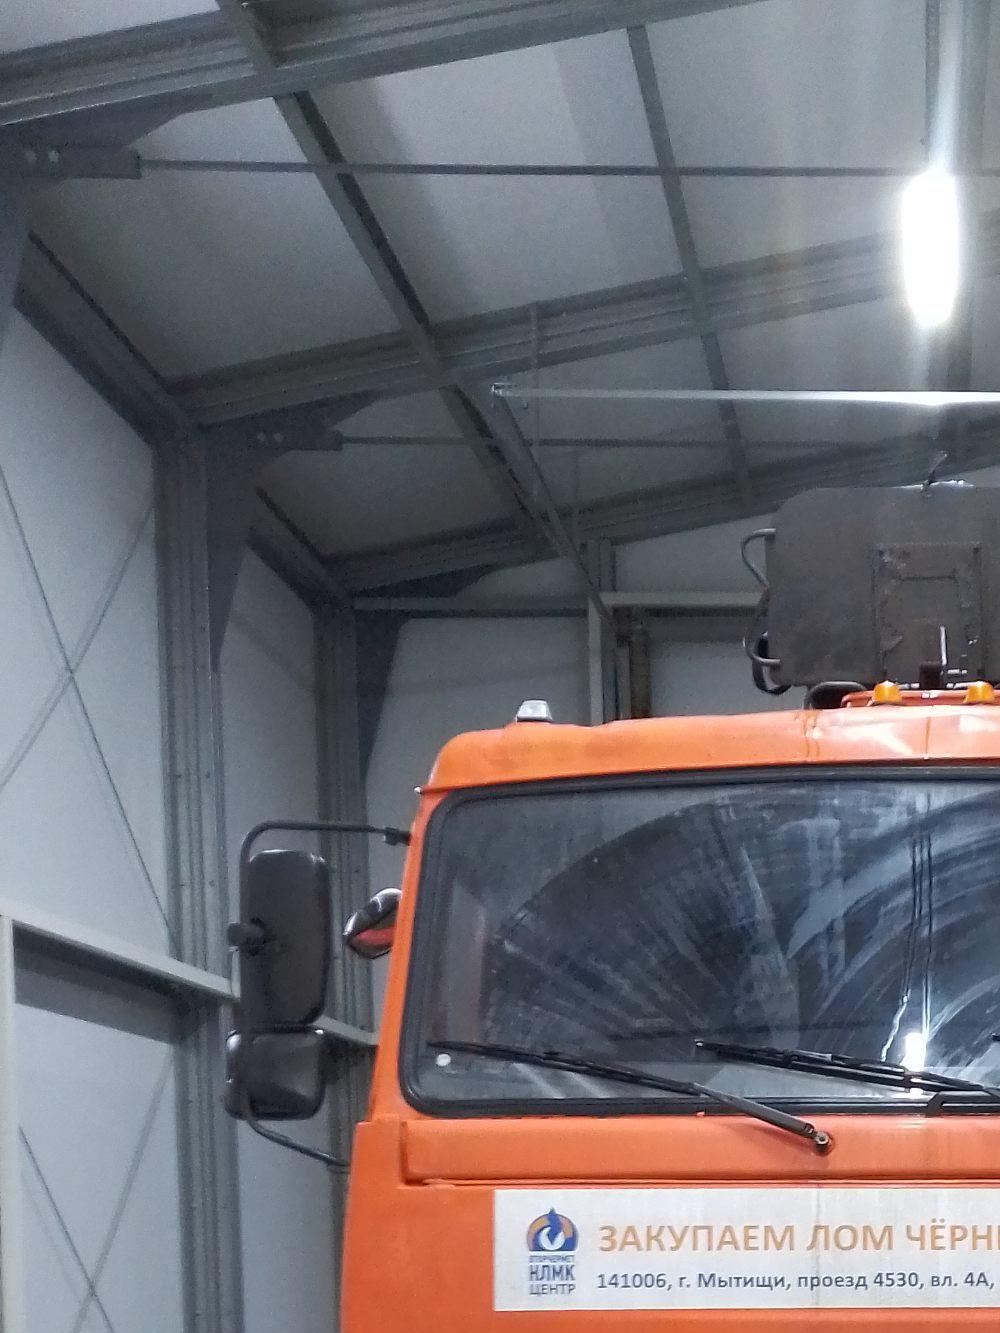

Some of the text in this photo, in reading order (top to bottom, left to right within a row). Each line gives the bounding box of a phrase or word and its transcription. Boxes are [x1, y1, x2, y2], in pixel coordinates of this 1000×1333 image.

[599, 1224, 796, 1253] ЗАКУПАЕМ
[806, 1224, 895, 1252] ЛОМ
[529, 1283, 576, 1295] ЦЕНТР
[597, 1272, 673, 1292] 141006,
[678, 1276, 691, 1289] г.
[697, 1272, 792, 1292] Мытищи,
[797, 1275, 868, 1294] проезд
[873, 1272, 925, 1291] 4530,
[930, 1275, 958, 1288] вл.
[963, 1271, 995, 1291] 4А,
